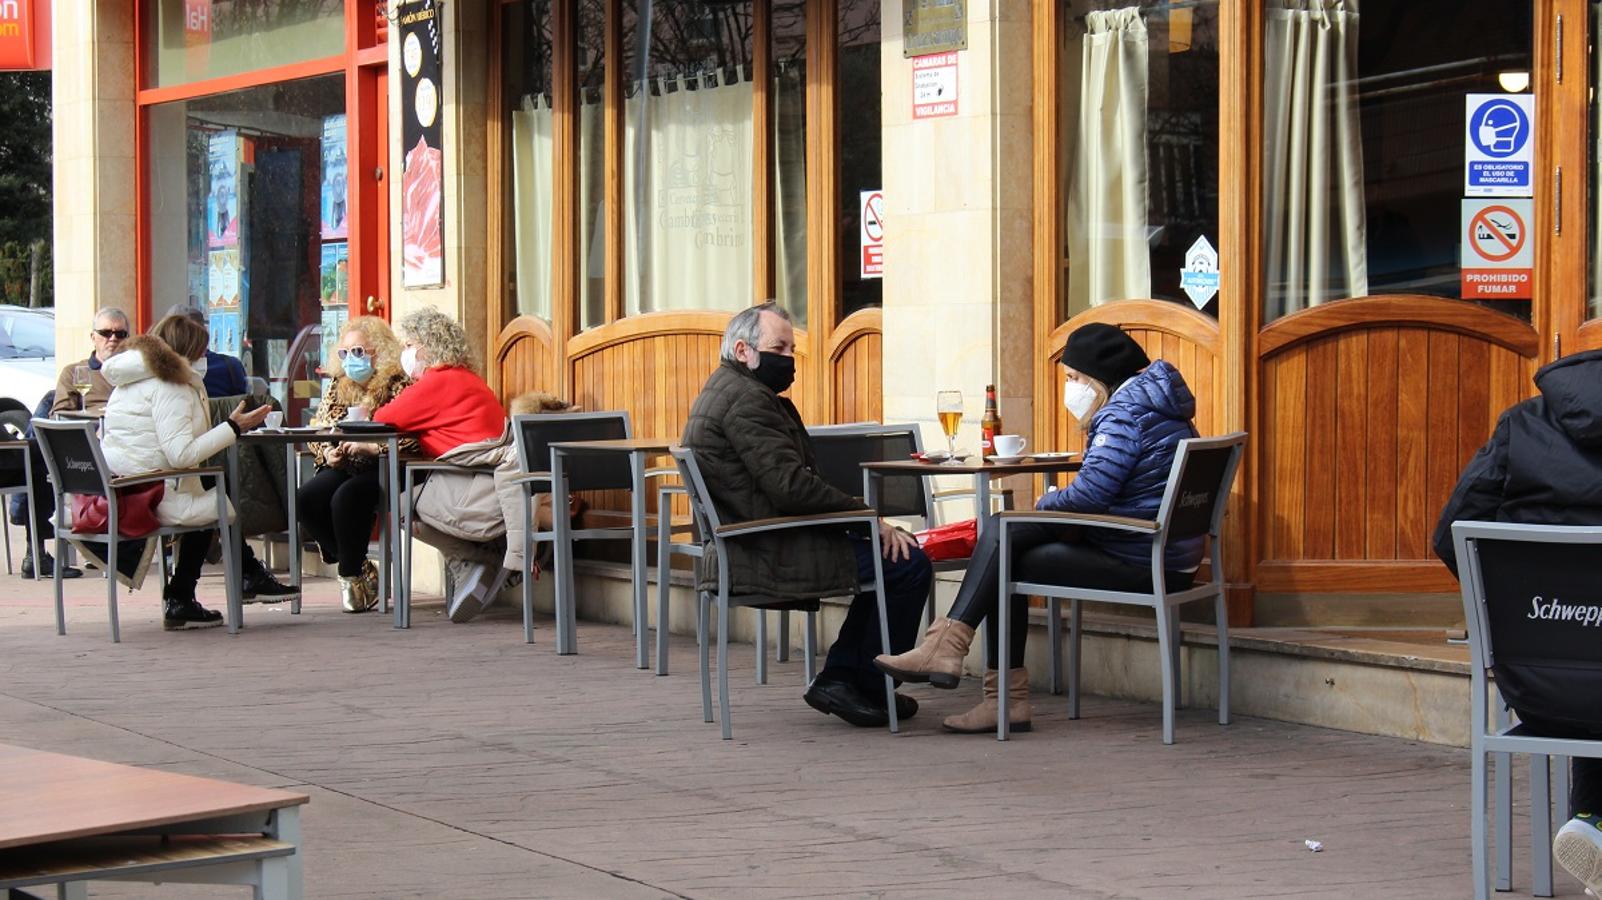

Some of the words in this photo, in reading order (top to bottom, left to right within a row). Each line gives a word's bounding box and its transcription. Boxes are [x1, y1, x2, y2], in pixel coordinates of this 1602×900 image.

[948, 54, 957, 65] DE
[914, 102, 955, 117] VIGILANCIA
[1466, 274, 1528, 283] PROHIBIDO
[1477, 285, 1517, 293] FUMAR
